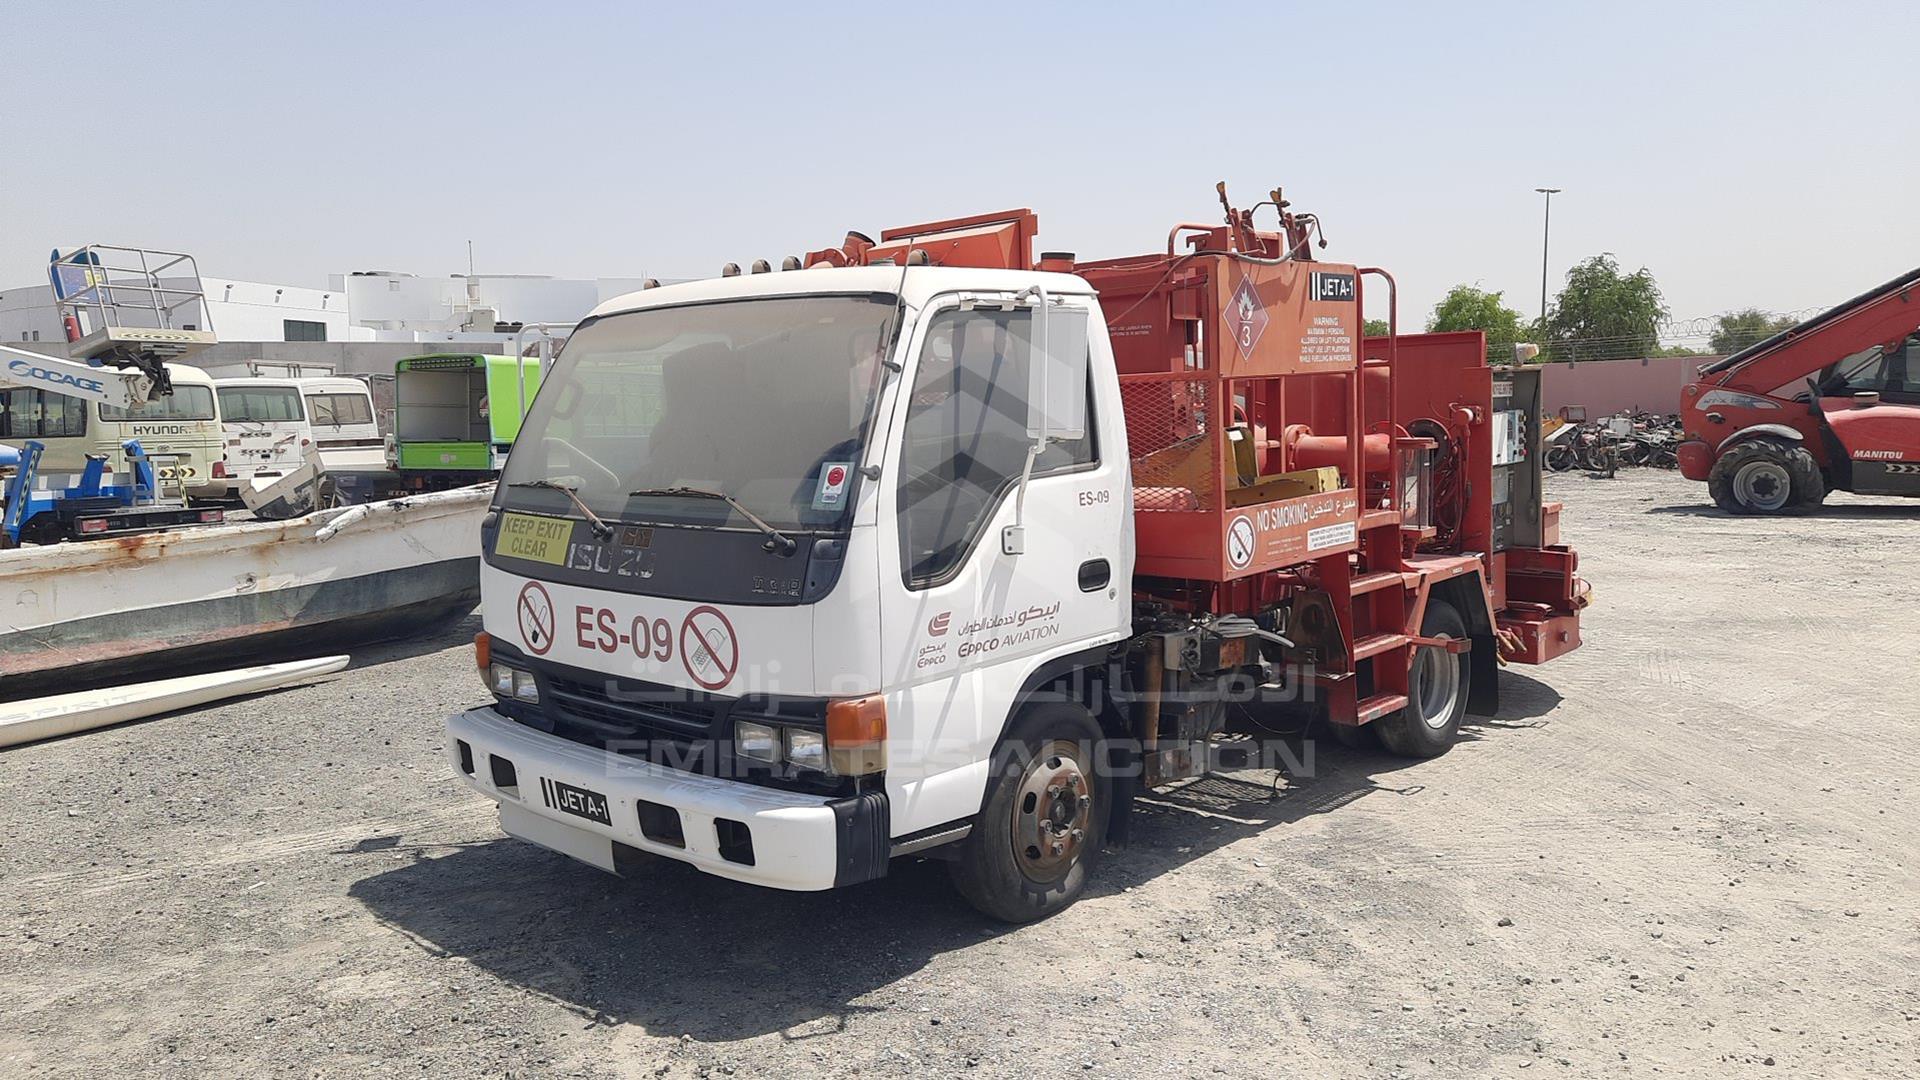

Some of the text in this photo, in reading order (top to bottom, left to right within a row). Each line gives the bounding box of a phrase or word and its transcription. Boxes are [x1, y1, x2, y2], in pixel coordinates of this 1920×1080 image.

[1242, 325, 1251, 347] 3
[8, 360, 104, 394] SOCAGE
[1853, 449, 1904, 460] MANITOU
[1079, 490, 1109, 506] ES-09
[1335, 497, 1356, 516] ممنوع
[504, 516, 567, 540] KEEP EXIT
[1256, 502, 1309, 532] NO SMOKING
[511, 537, 548, 558] CLEAR
[576, 605, 673, 662] ES-09
[958, 623, 1060, 658] EPPCO AVIATION
[917, 654, 947, 669] EPPCO
